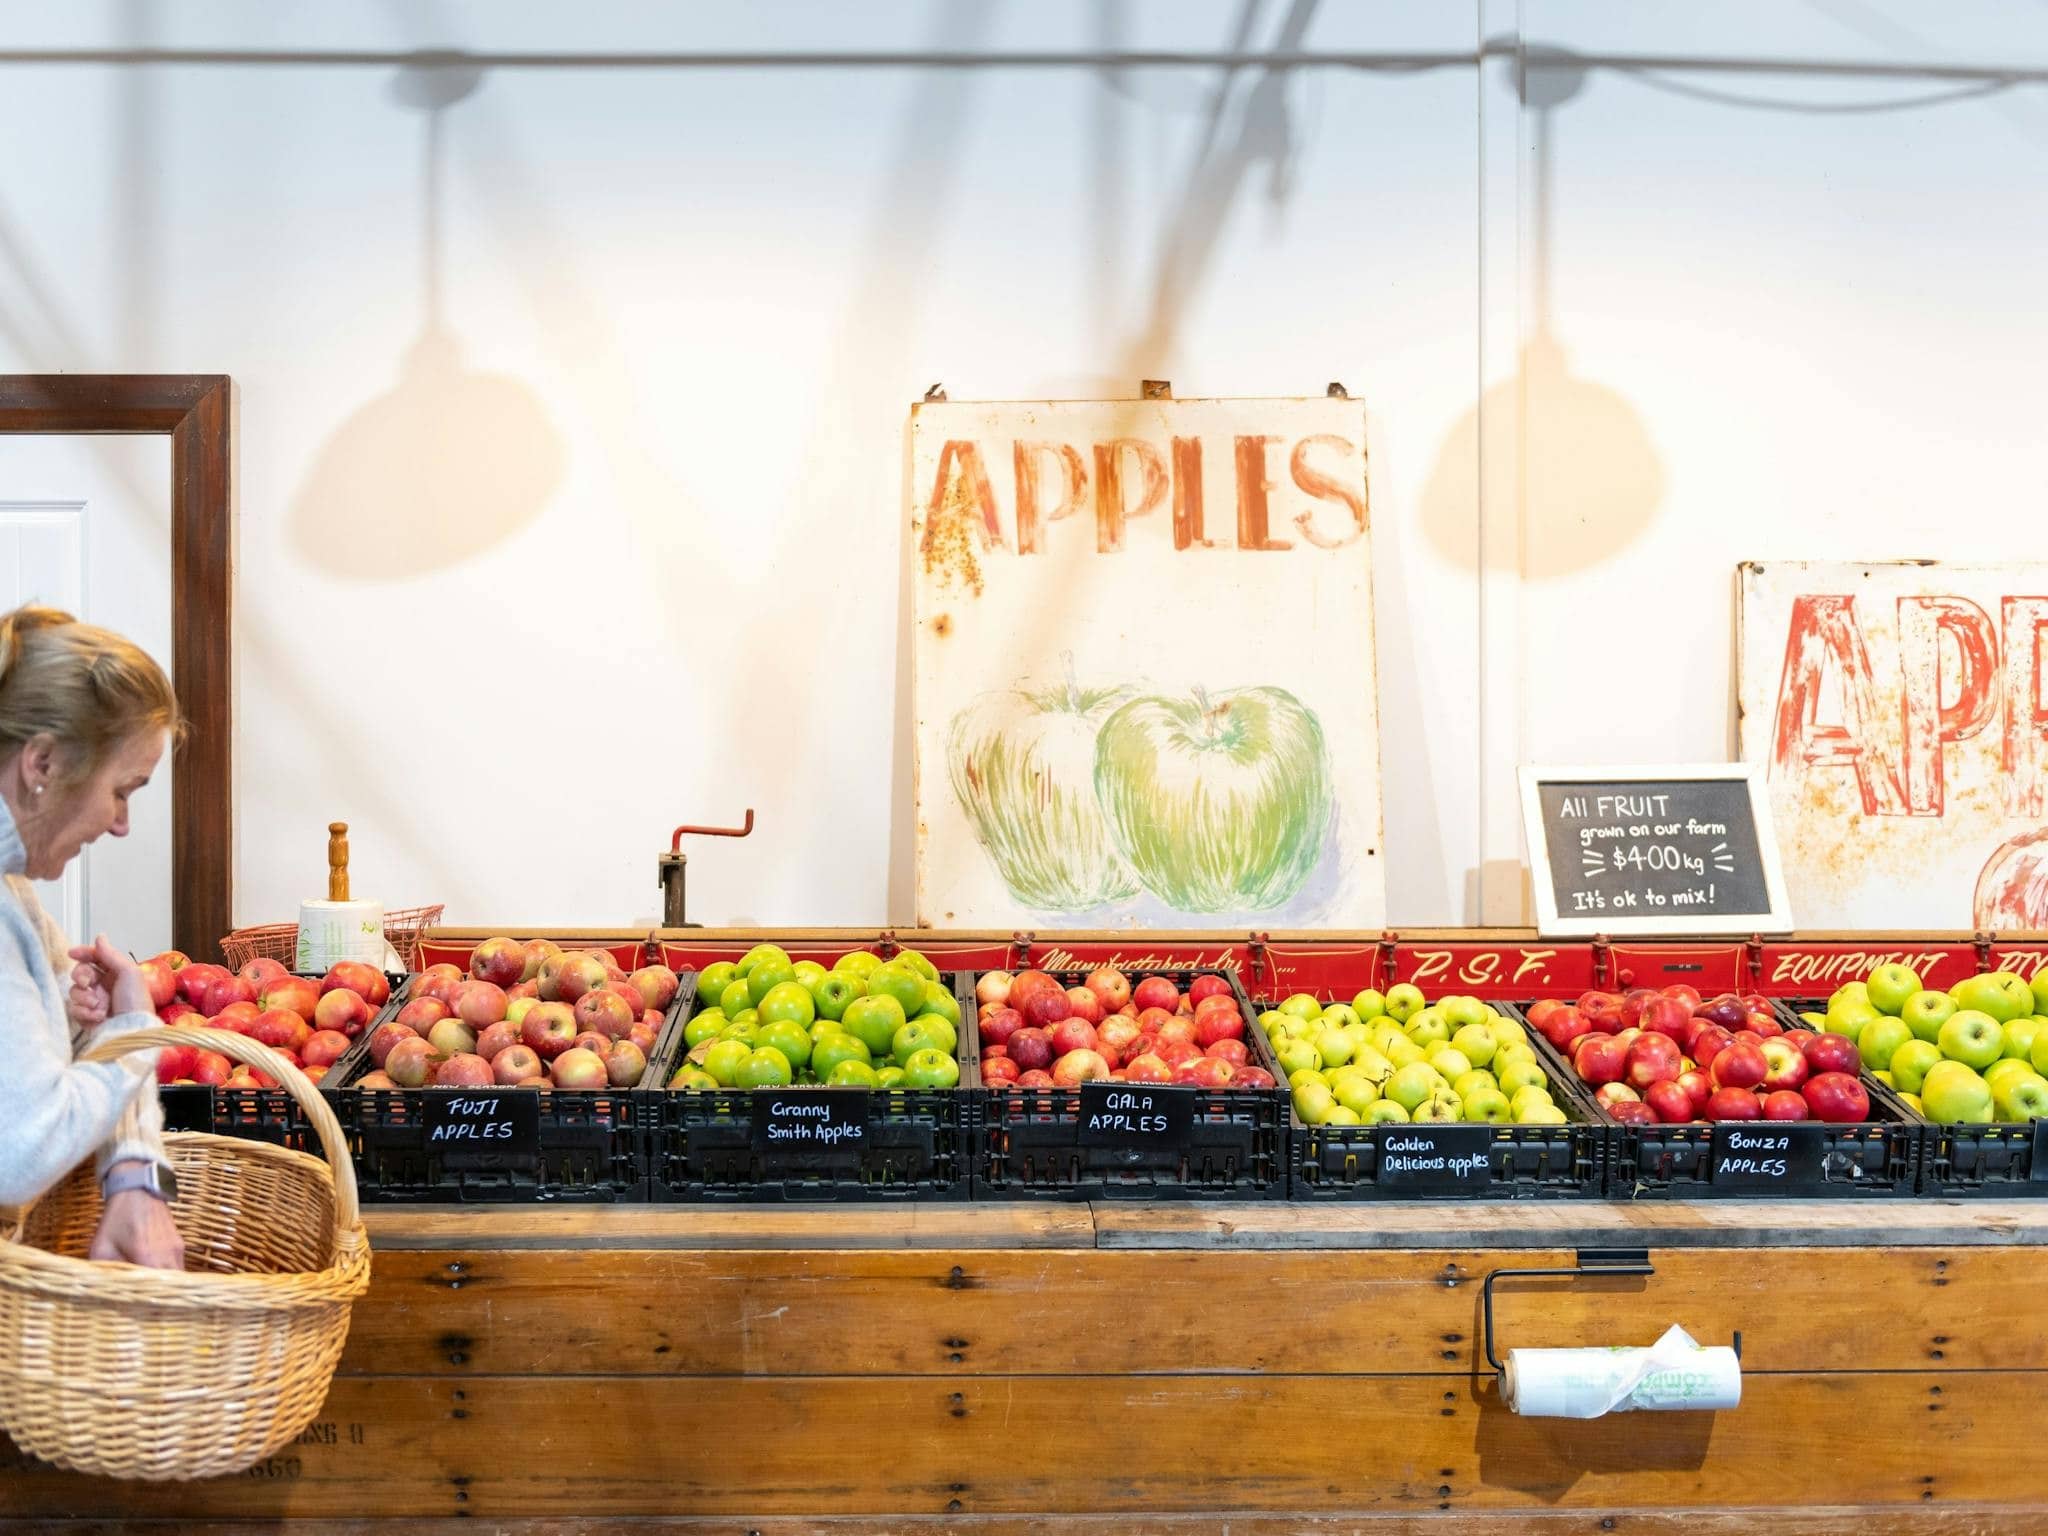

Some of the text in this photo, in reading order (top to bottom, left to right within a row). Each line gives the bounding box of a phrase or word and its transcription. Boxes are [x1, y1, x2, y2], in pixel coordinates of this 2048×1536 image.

[920, 434, 1370, 554] APPLES
[1560, 795, 1669, 818] All FRUIT
[1580, 818, 1726, 846] grown on our farm
[1572, 883, 1715, 911] It's ok to mix!
[446, 1097, 500, 1115] FUJI
[1106, 1093, 1153, 1110] GALA
[771, 1102, 830, 1122] Granny
[432, 1121, 513, 1141] APPLES
[767, 1121, 862, 1145] Smith Apples
[1089, 1114, 1168, 1132] APPLES
[1385, 1136, 1435, 1151] Golden
[1385, 1153, 1489, 1177] Delicious apples
[1719, 1158, 1786, 1176] APPLES
